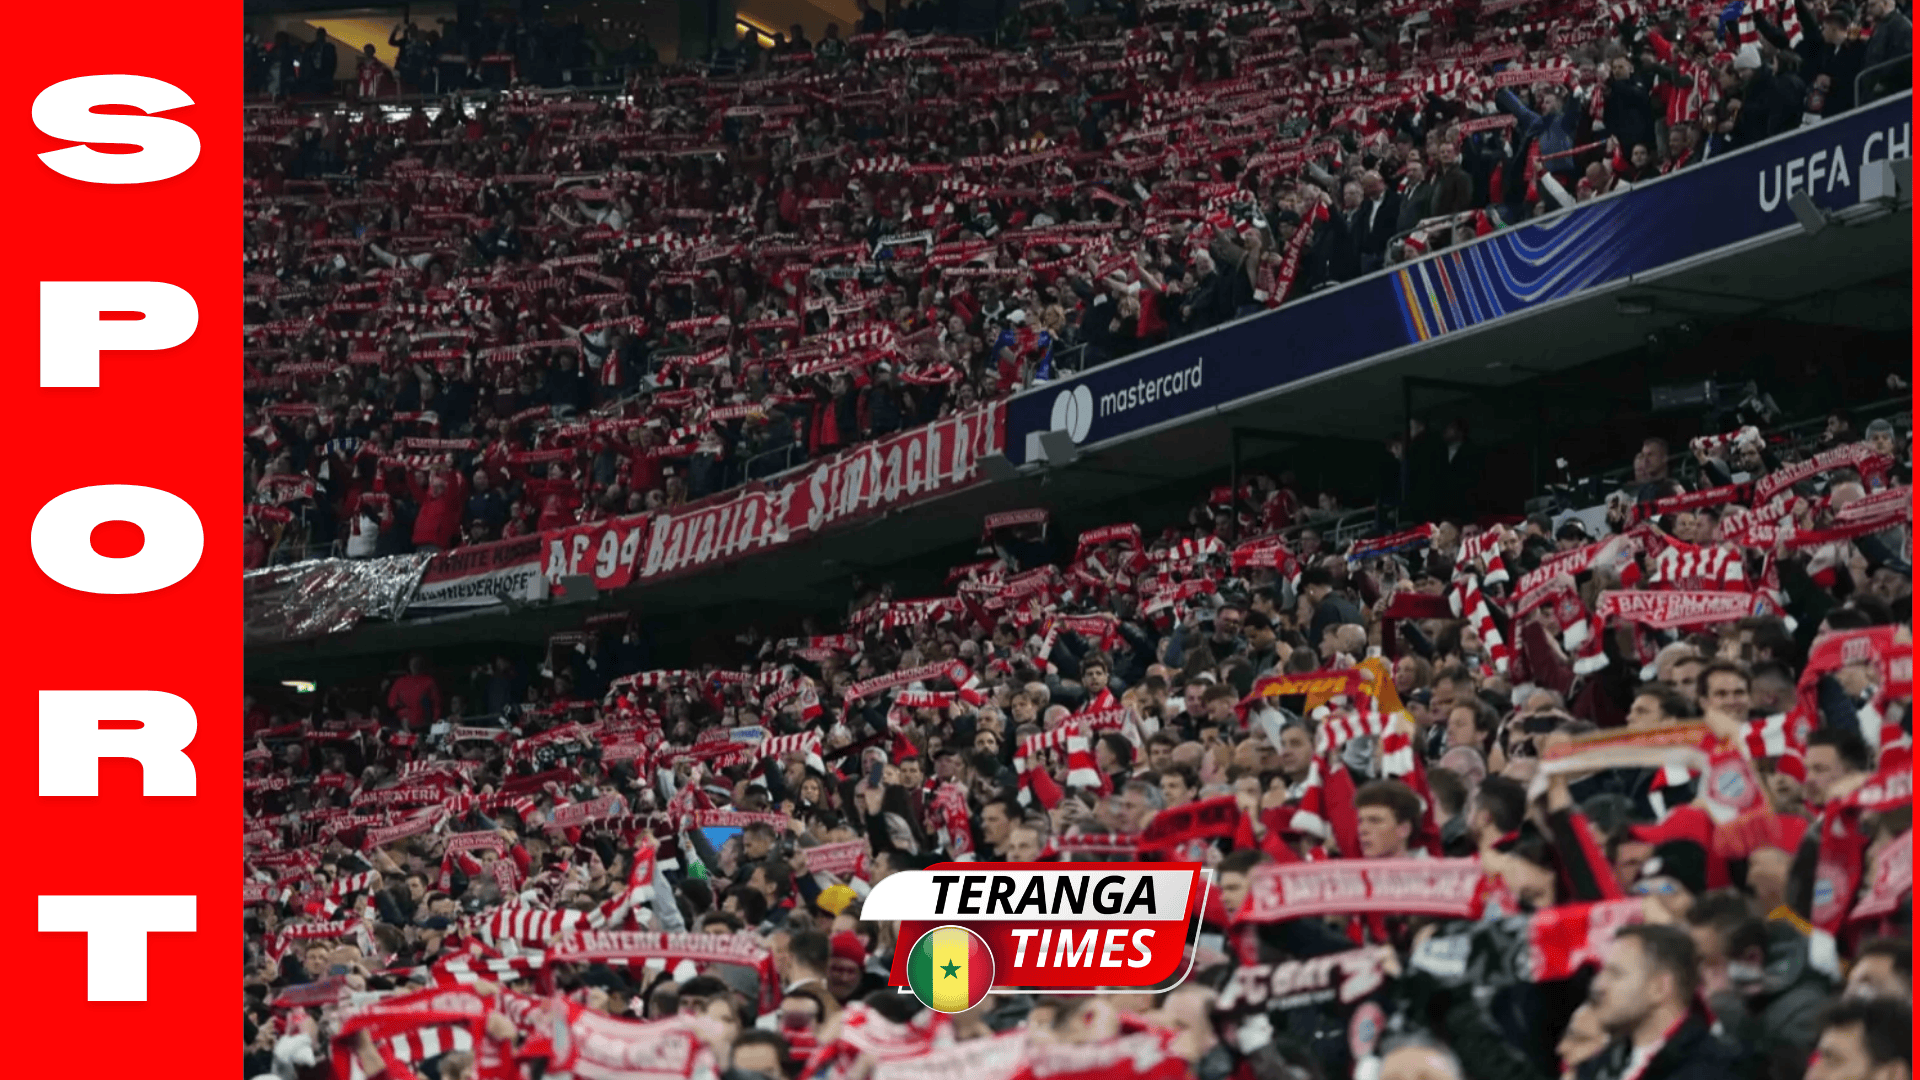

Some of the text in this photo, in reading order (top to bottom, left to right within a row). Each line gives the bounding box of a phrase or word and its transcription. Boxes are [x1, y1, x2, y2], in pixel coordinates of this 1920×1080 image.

[1759, 144, 1850, 213] UEFA
[1100, 357, 1203, 418] mastercard
[640, 499, 758, 577] Bavaria
